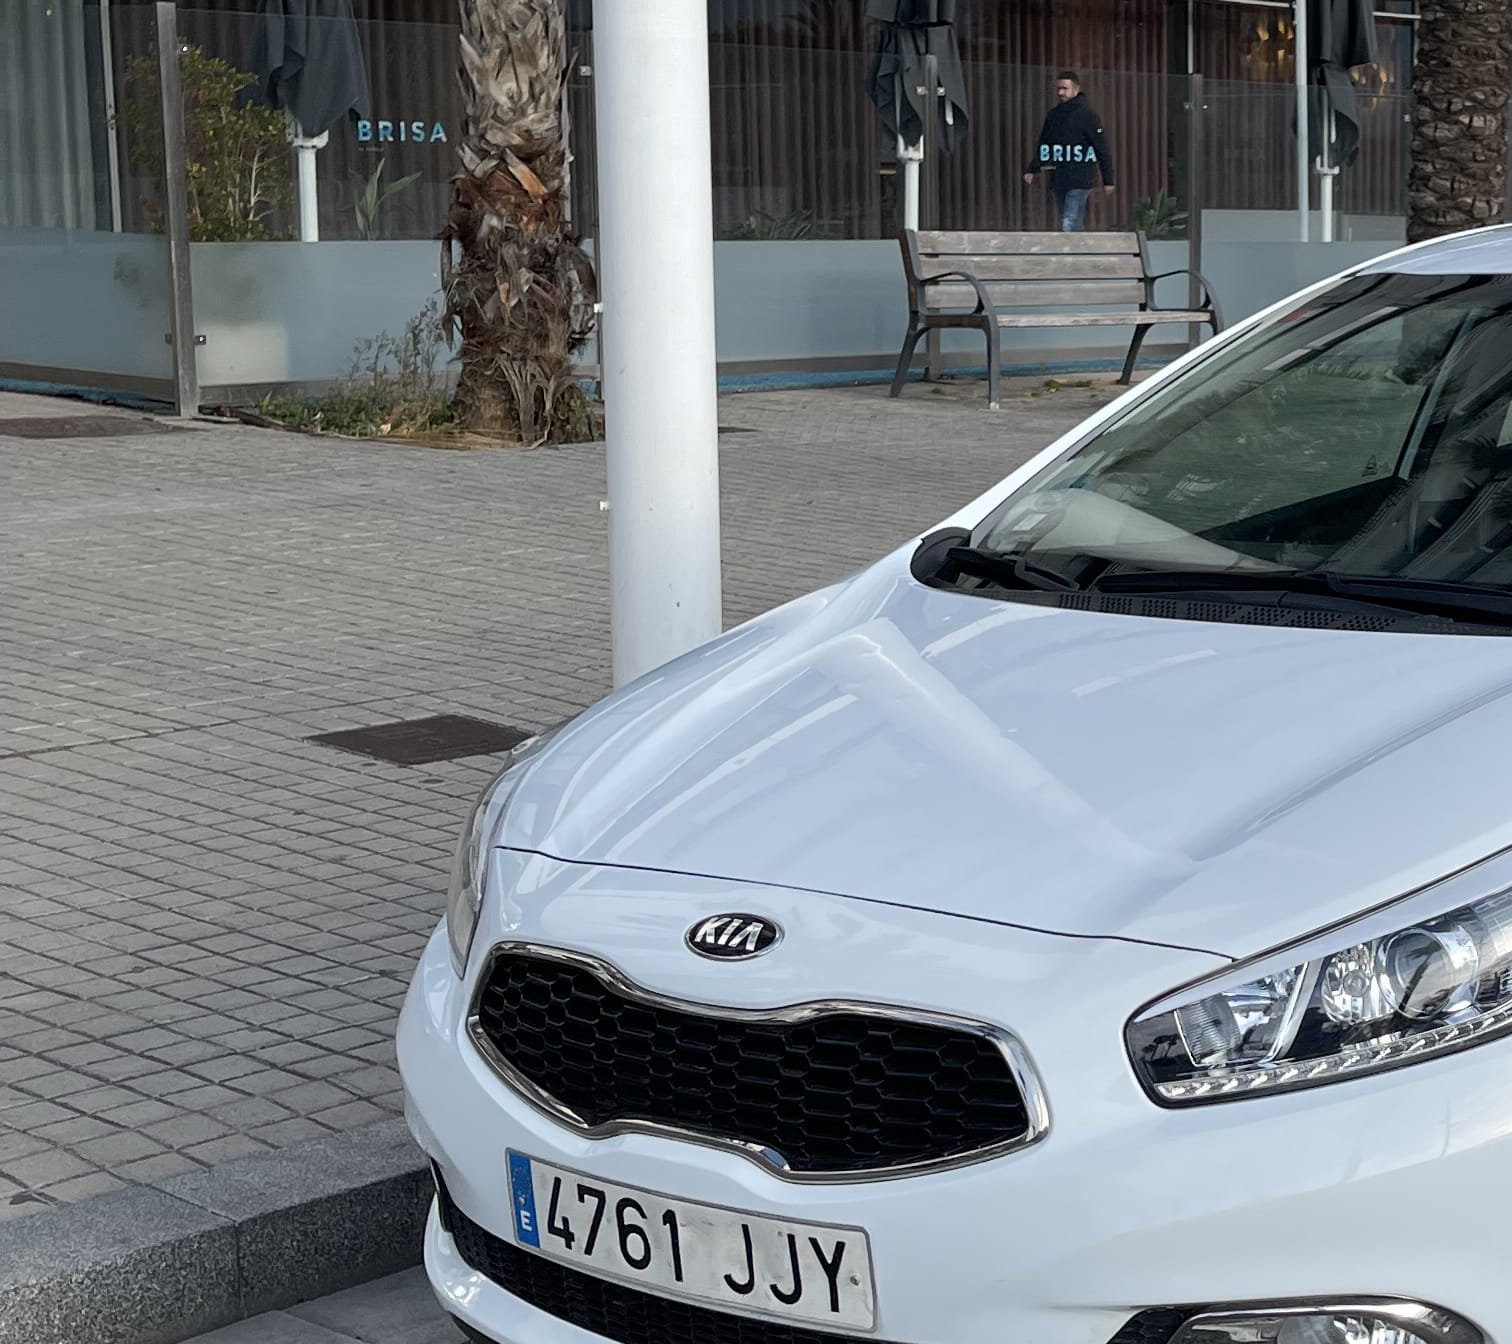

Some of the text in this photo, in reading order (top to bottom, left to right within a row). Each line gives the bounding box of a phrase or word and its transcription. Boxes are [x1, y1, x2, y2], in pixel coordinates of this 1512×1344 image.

[357, 119, 448, 143] BRISA
[1039, 143, 1097, 162] BRISA
[694, 916, 764, 952] KIA
[520, 1176, 847, 1313] E 4761 JJY
